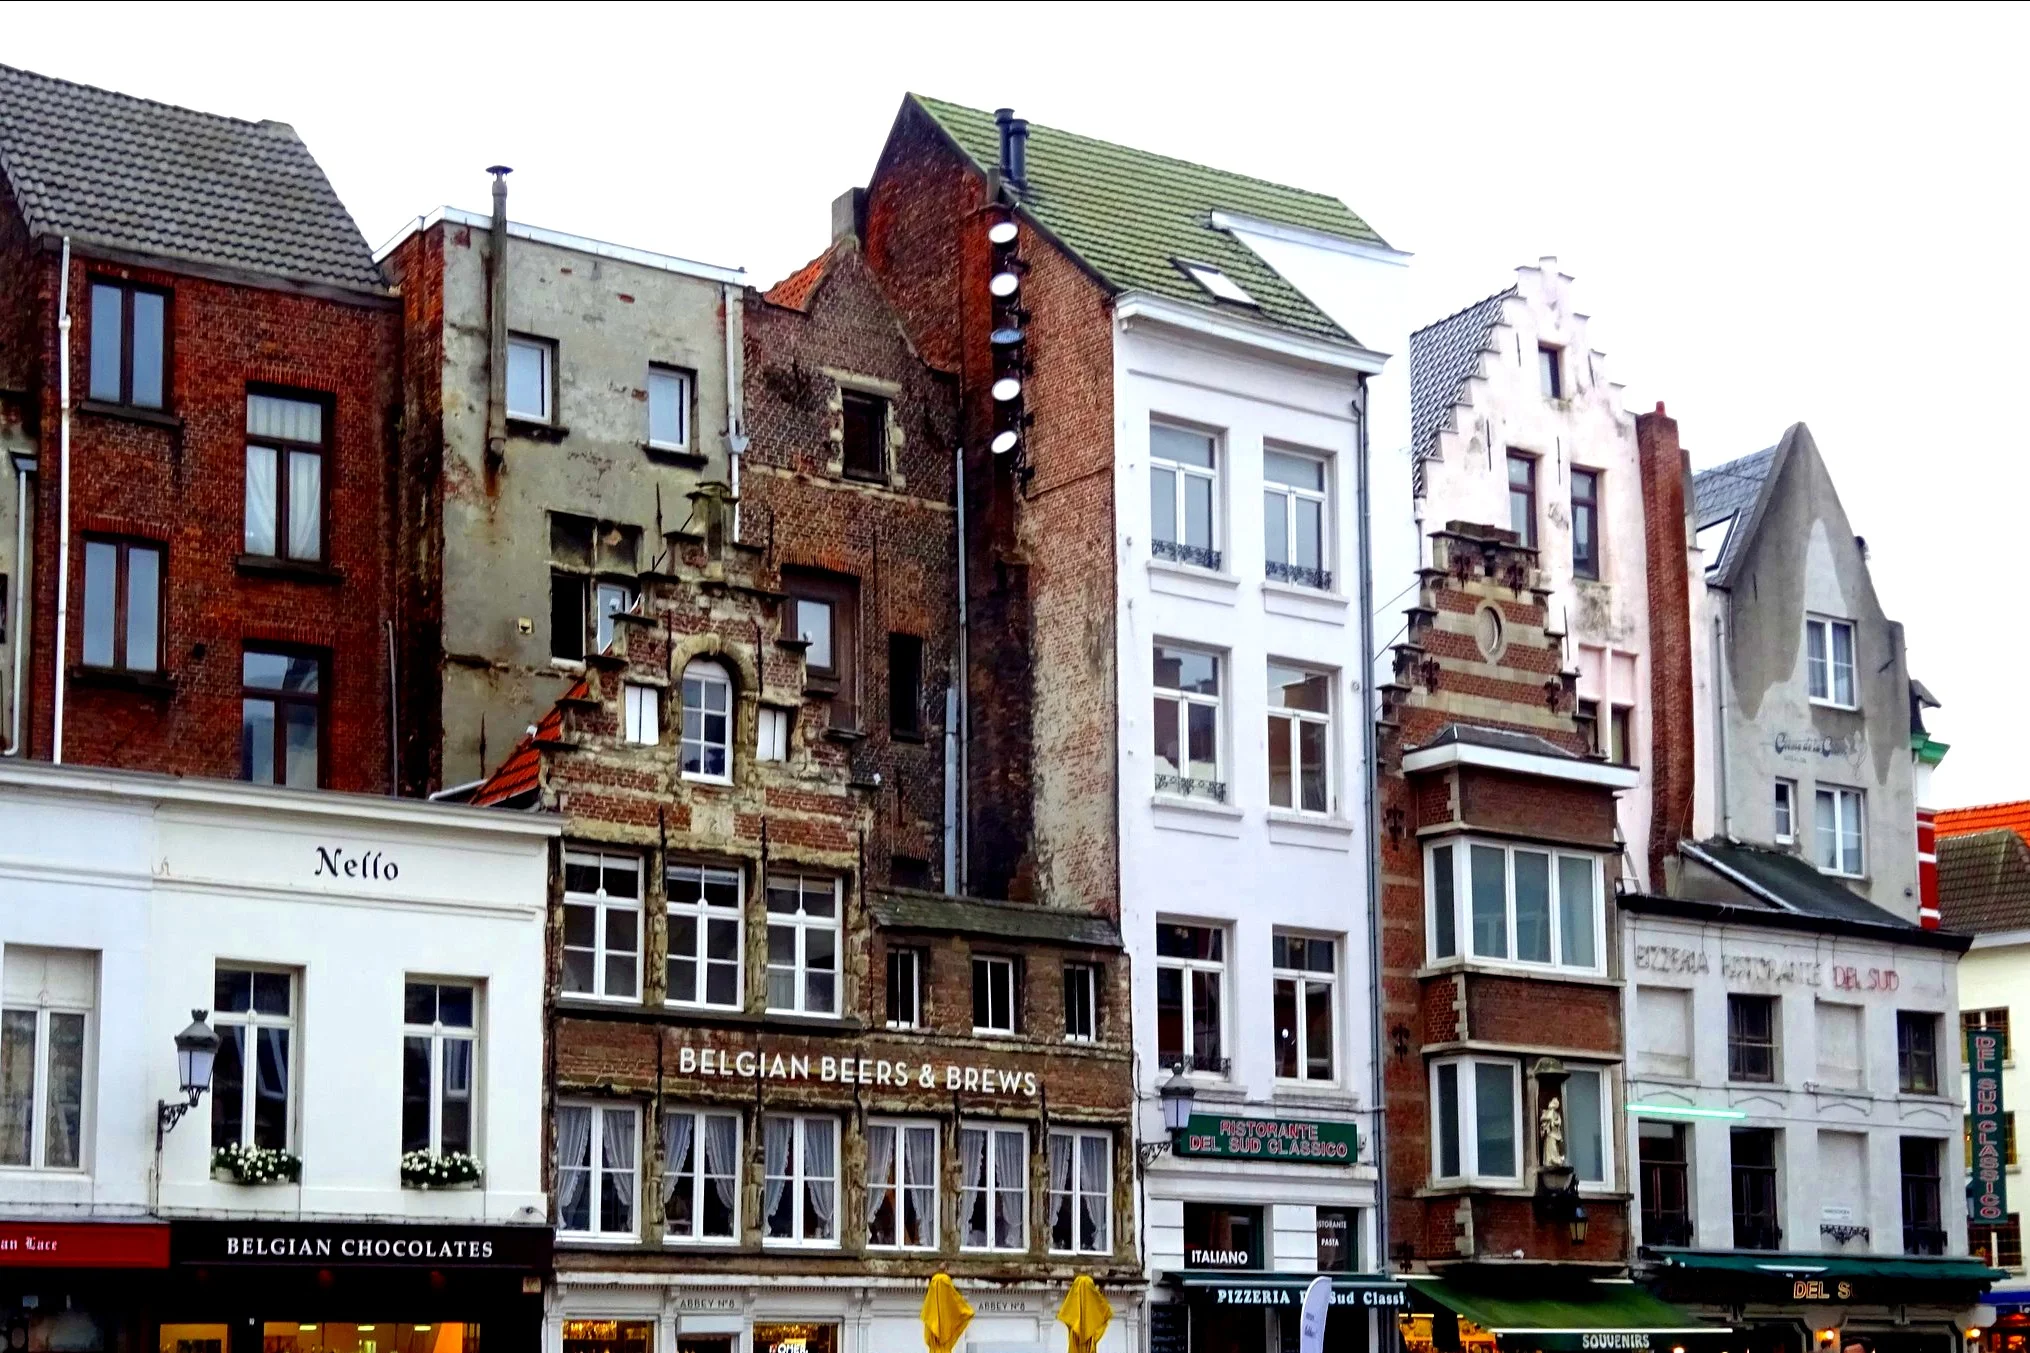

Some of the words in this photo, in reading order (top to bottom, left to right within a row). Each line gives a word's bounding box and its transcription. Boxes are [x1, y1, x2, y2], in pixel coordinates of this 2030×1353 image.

[314, 846, 399, 881] Nello
[1833, 965, 1861, 991] DEL
[1868, 967, 1900, 991] SUD
[1975, 1036, 1996, 1073] DEL
[679, 1047, 809, 1080] BELGIAN
[820, 1056, 909, 1088] BEERS
[918, 1063, 936, 1089] &
[946, 1066, 1037, 1097] BREWS
[1977, 1078, 1998, 1116] SUD
[1220, 1119, 1319, 1141] RISTORANTE
[1189, 1135, 1222, 1152] DEL
[1229, 1136, 1262, 1154] SUD
[1267, 1139, 1348, 1158] CLASSICO
[1977, 1120, 2002, 1219] CLASSICO
[26, 1236, 58, 1251] Lace
[227, 1237, 332, 1256] BELGIAN
[341, 1239, 493, 1257] CHOCOLATES
[1321, 1238, 1339, 1247] PASTA
[1191, 1249, 1249, 1265] ITALIANO
[1217, 1289, 1290, 1304] PIZZERIA
[1793, 1280, 1830, 1299] DEL
[680, 1299, 713, 1309] ABBEY
[978, 1301, 1007, 1311] ABBEY
[1582, 1334, 1650, 1350] SOUVENIRS
